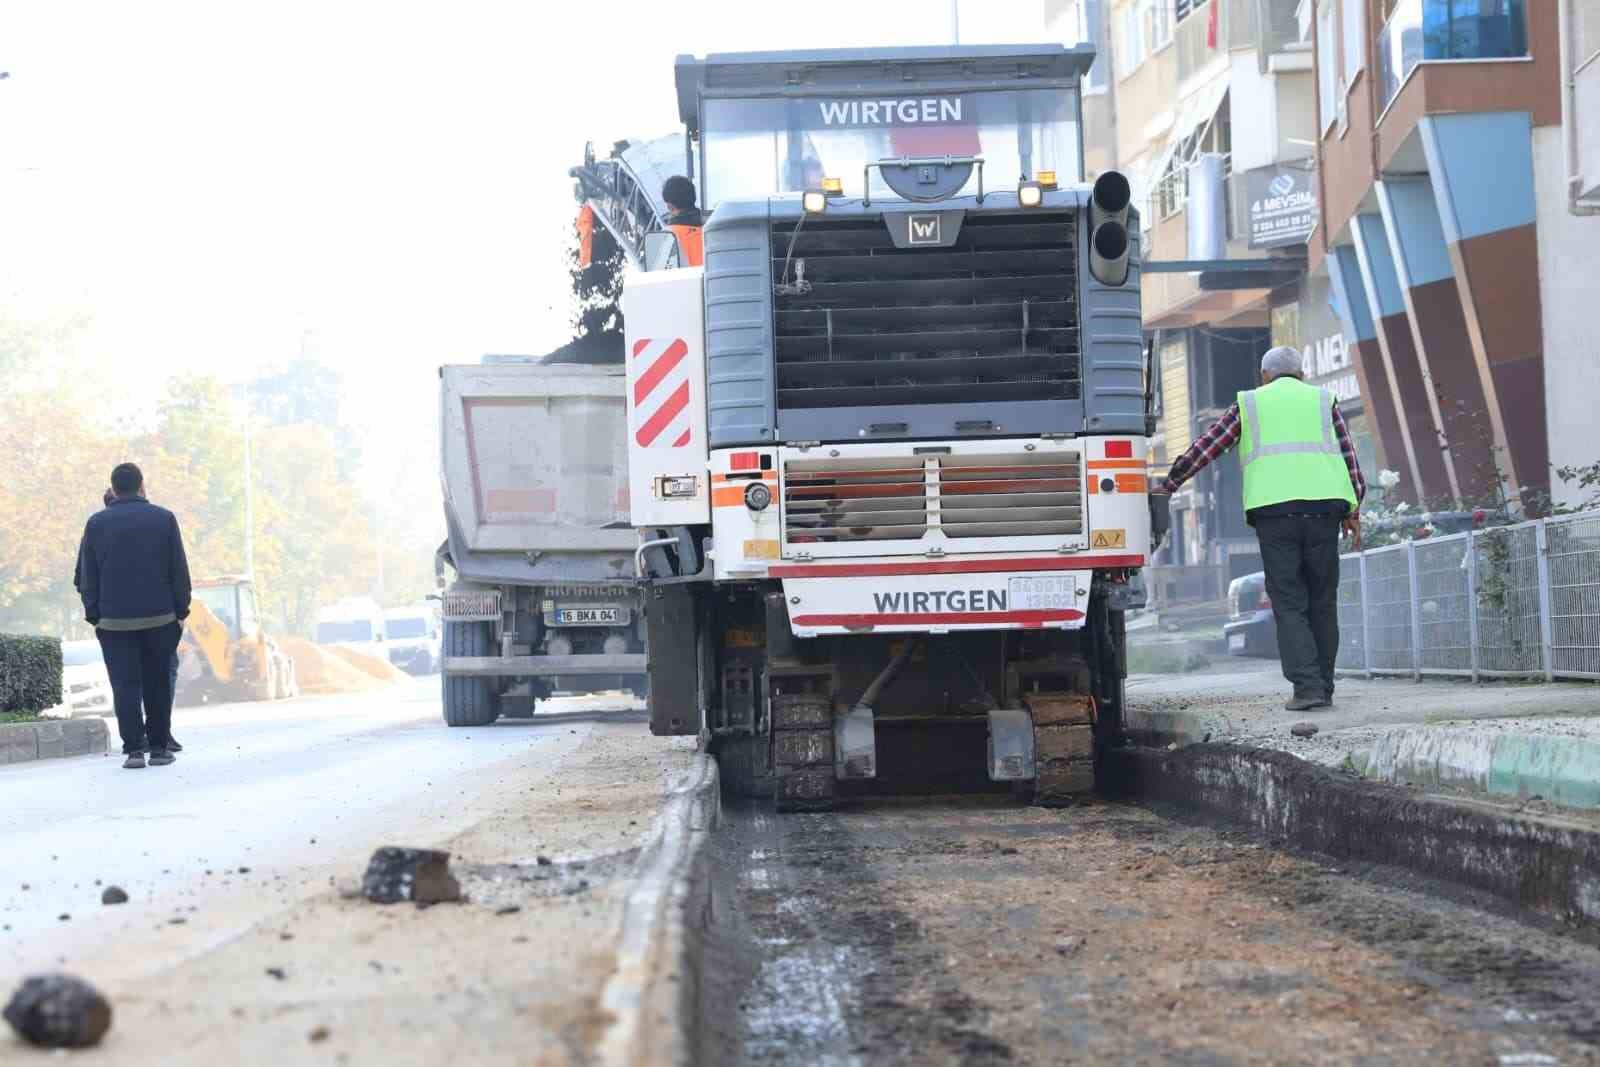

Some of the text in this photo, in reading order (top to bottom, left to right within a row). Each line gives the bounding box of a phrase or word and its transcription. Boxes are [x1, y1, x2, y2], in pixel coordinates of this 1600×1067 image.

[820, 98, 962, 125] WIRTGEN
[1251, 199, 1260, 212] 4
[912, 221, 936, 238] W
[1301, 344, 1312, 379] 4
[873, 589, 1007, 613] WIRTGEN
[563, 610, 617, 622] 16 BKA 041
